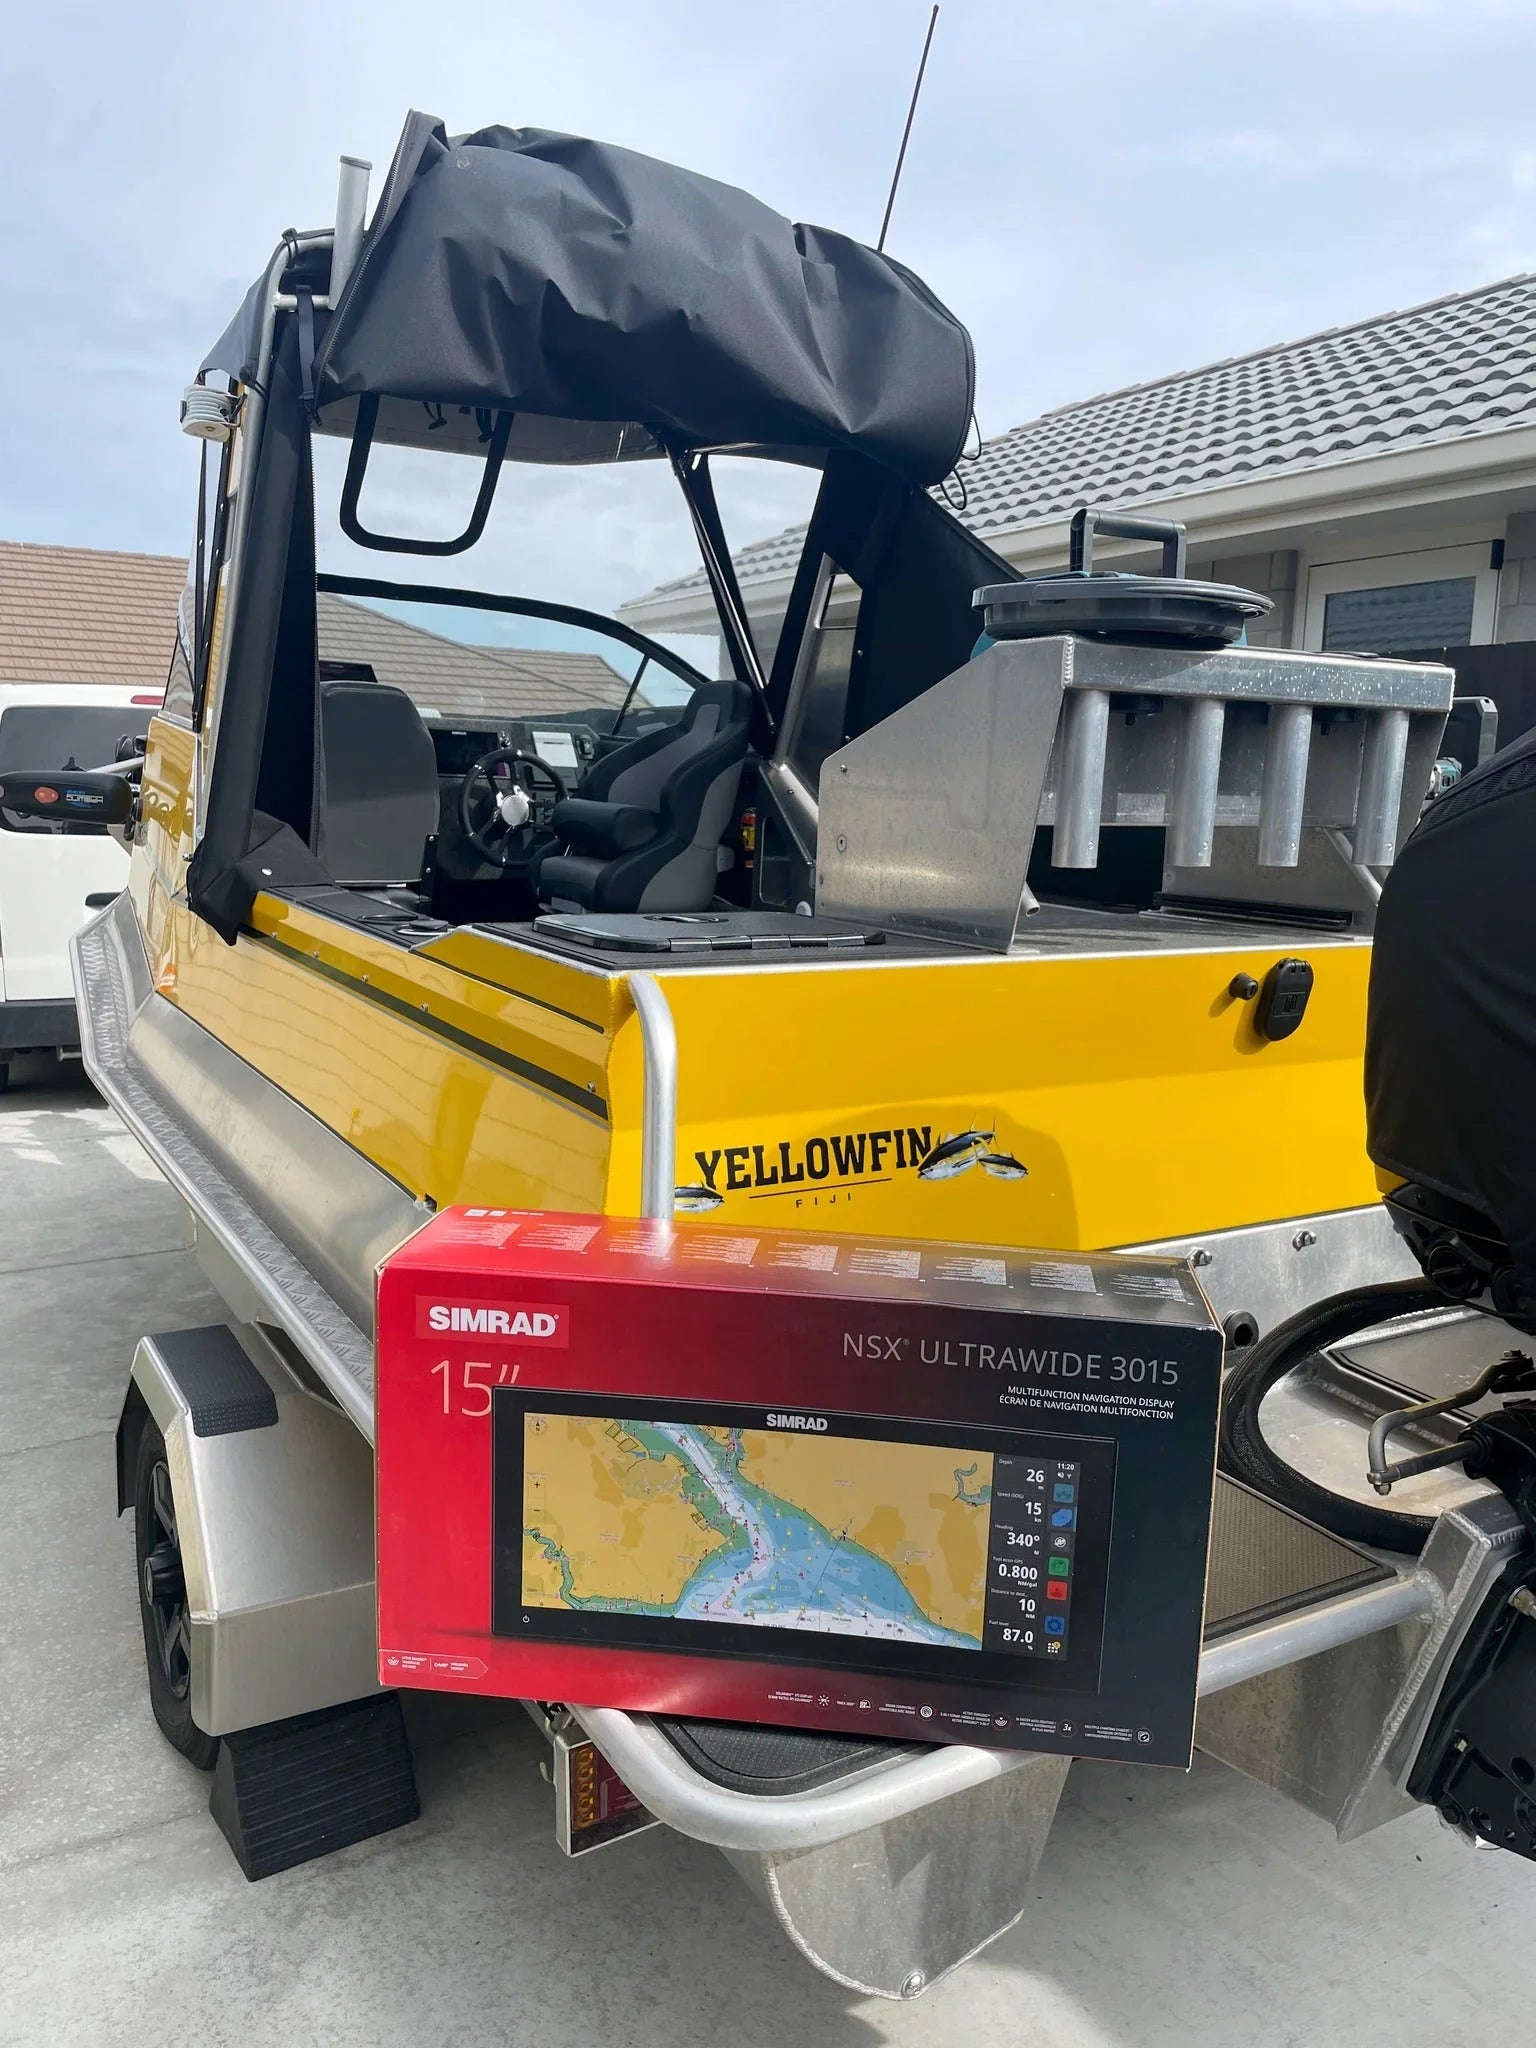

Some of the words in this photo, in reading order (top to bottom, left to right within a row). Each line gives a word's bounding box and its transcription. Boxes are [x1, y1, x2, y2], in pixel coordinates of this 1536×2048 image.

[694, 1126, 932, 1191] YELLOWFIN
[795, 1192, 854, 1208] FIJI
[919, 1339, 1102, 1380] ULTRAWIDE
[1109, 1355, 1179, 1386] 3015
[1007, 1385, 1080, 1401] MULTIFUNCTION
[1082, 1391, 1137, 1406] NAVIGATION
[1138, 1395, 1175, 1409] DISPLAY
[999, 1394, 1027, 1407] ÉCRAN
[1028, 1397, 1042, 1408] DE
[1043, 1398, 1098, 1413] NAVIGATION
[1099, 1404, 1174, 1419] MULTIFONCTION
[766, 1413, 828, 1432] SIMRAD
[1026, 1468, 1045, 1483] 26
[1025, 1501, 1042, 1516] 15
[1006, 1532, 1041, 1547] 340°
[998, 1563, 1038, 1580] 0.800
[1018, 1598, 1036, 1612] 10
[1002, 1628, 1034, 1644] 87.0
